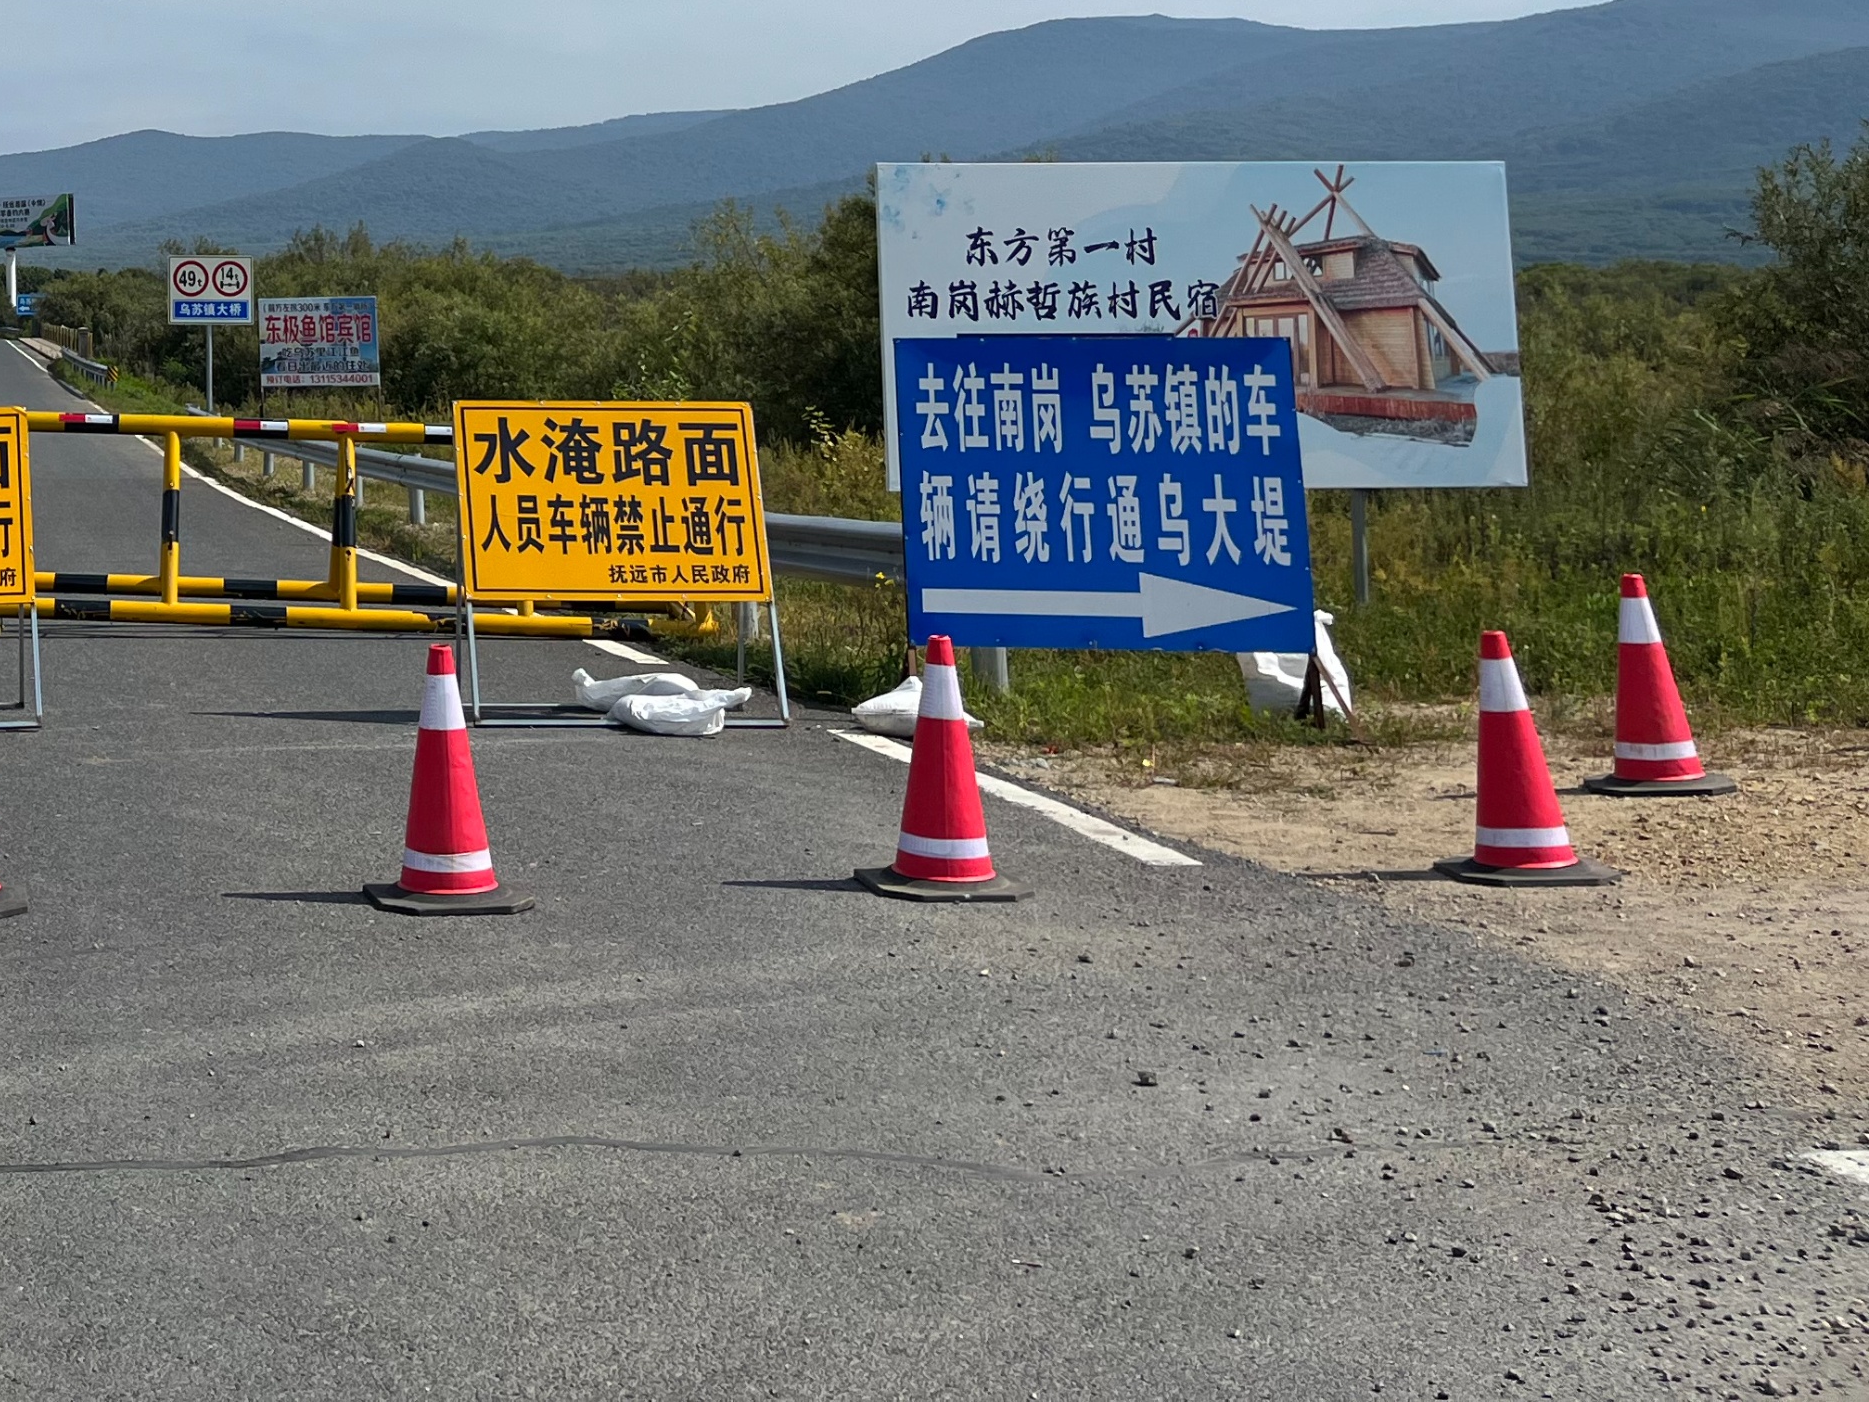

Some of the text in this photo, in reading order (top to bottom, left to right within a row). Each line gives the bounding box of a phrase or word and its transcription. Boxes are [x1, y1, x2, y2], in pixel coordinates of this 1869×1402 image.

[964, 226, 1159, 268] 东方第一村
[179, 303, 242, 316] 乌苏镇大桥
[906, 278, 1220, 321] 南岗赫哲族村民宿
[265, 314, 372, 345] 东极鱼馆宾馆
[914, 362, 1282, 456] 去往南岗 乌苏镇的车
[473, 416, 739, 486] 水淹路面
[481, 492, 746, 557] 人员车辆禁止通行
[918, 470, 1293, 567] 辆请绕行通乌大堤
[607, 563, 751, 585] 抚远市人民政府
